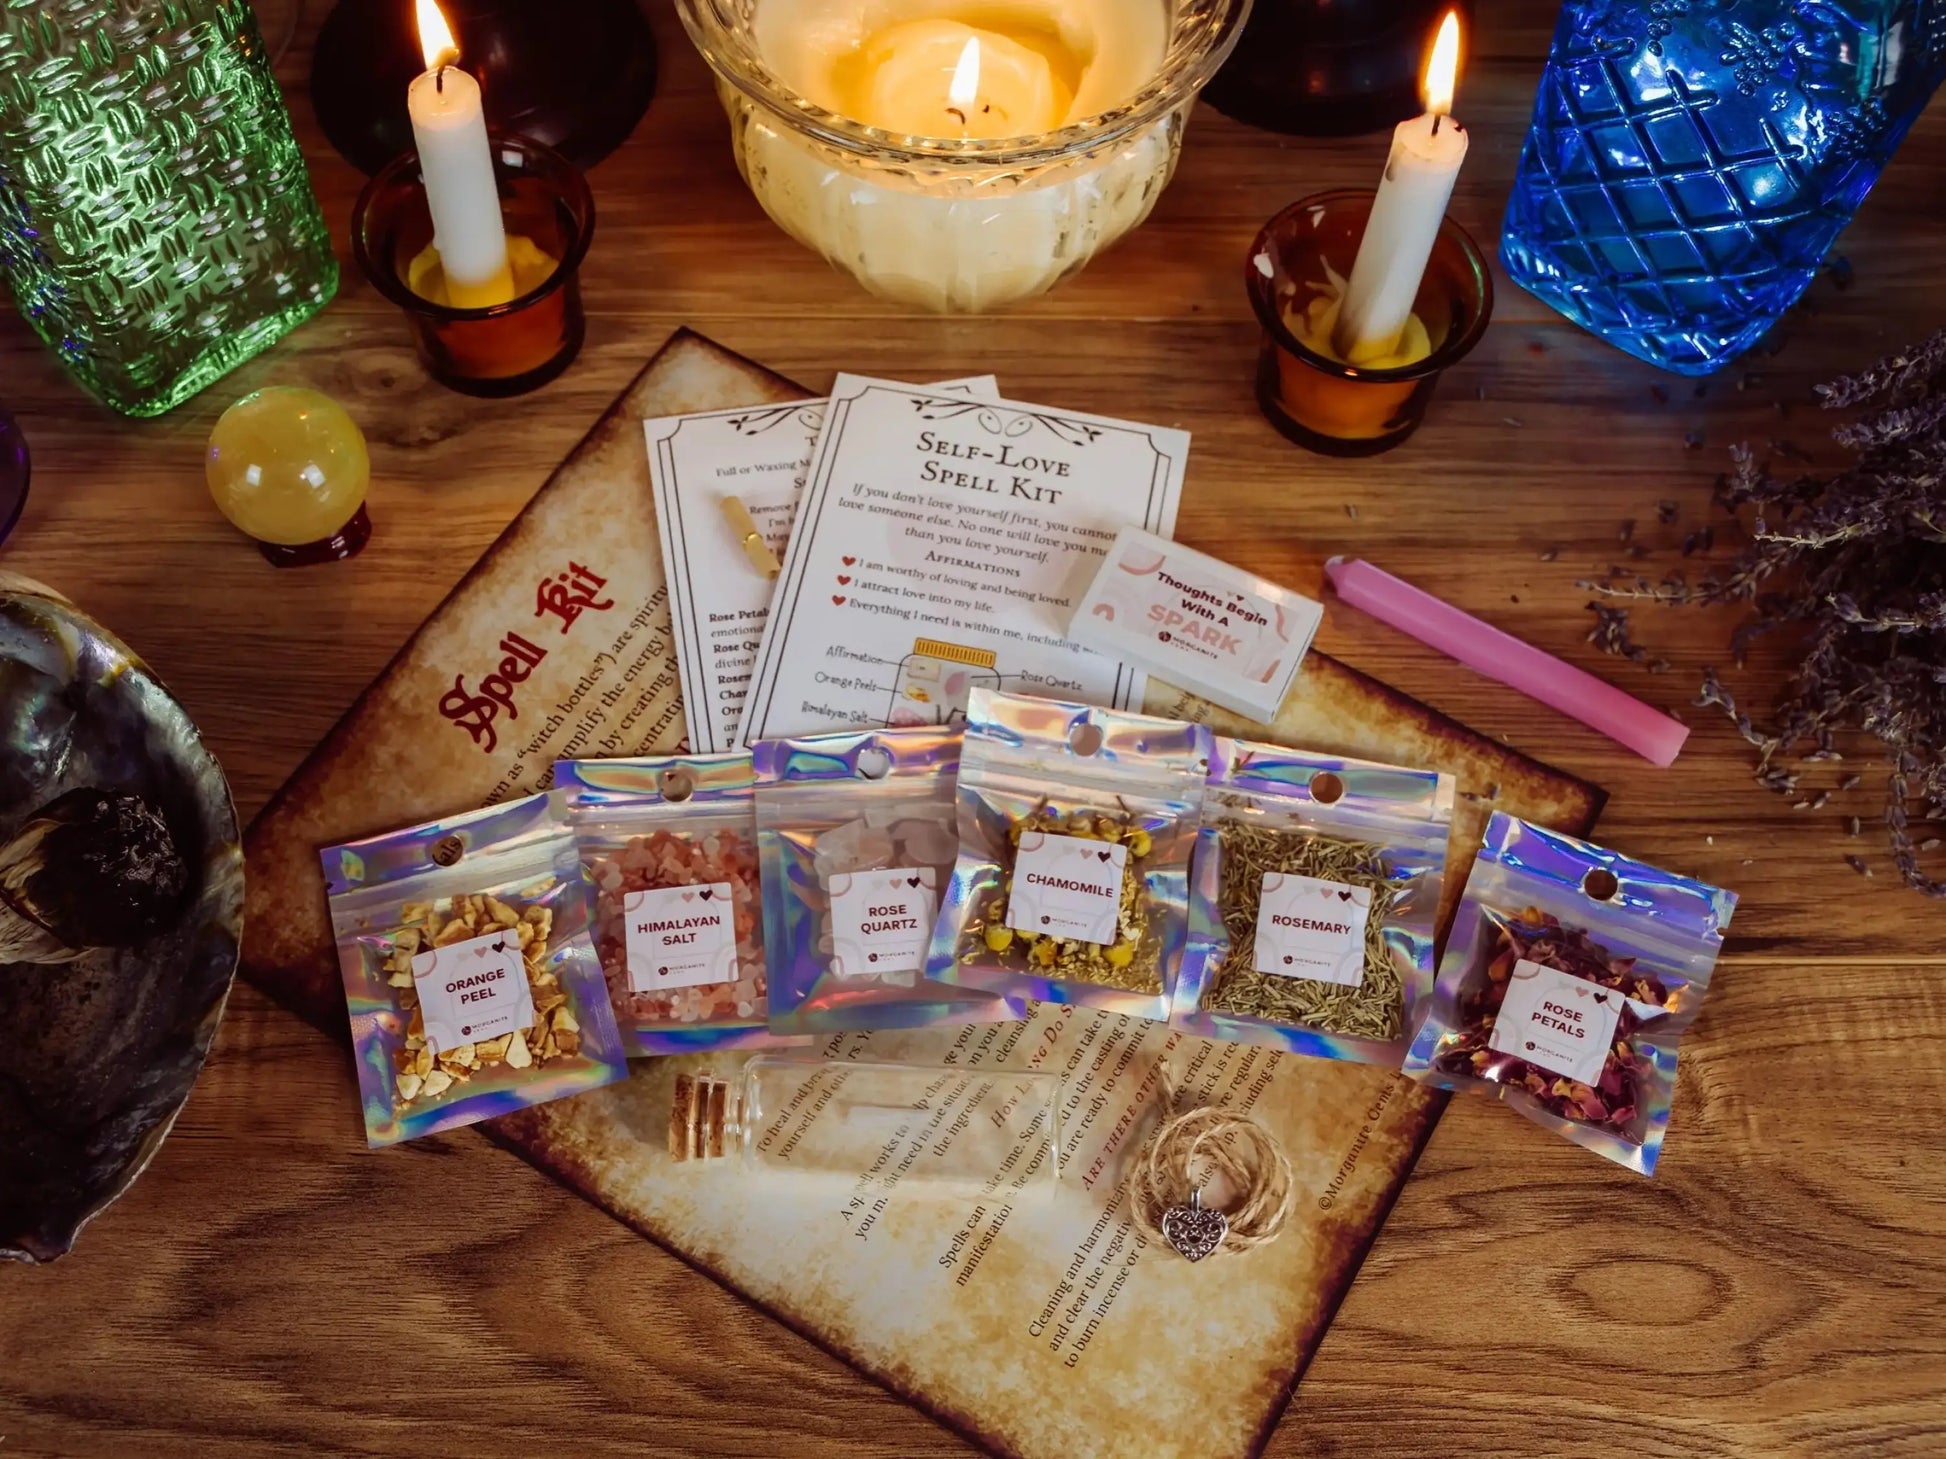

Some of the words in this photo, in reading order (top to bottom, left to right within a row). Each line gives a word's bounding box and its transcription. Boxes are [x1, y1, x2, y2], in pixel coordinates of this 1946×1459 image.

[716, 467, 737, 476] Full
[739, 467, 751, 475] or
[754, 460, 797, 472] Waxing
[838, 497, 865, 510] love
[867, 503, 923, 521] someone
[927, 512, 954, 527] else.
[958, 518, 976, 532] No
[979, 525, 1002, 536] one
[1006, 528, 1031, 542] will
[1035, 533, 1060, 547] love
[1063, 540, 1087, 552] you
[852, 483, 863, 496] If
[866, 487, 889, 501] you
[892, 490, 924, 505] don't
[928, 496, 953, 510] love
[956, 502, 1009, 522] yourself
[1010, 510, 1041, 528] first,
[1045, 519, 1068, 533] you
[905, 526, 934, 541] than
[939, 533, 962, 546] you
[965, 537, 991, 551] love
[994, 543, 1050, 563] yourself.
[854, 578, 860, 588] I
[861, 579, 899, 595] attract
[902, 587, 926, 600] love
[929, 592, 951, 605] into
[954, 599, 972, 611] my
[974, 600, 995, 613] life.
[859, 558, 866, 568] I
[865, 561, 884, 572] am
[886, 563, 927, 582] worthy
[929, 572, 942, 583] of
[944, 575, 978, 591] loving
[981, 581, 1002, 594] and
[1005, 585, 1042, 603] being
[1039, 592, 1072, 608] loved.
[1158, 571, 1223, 607] Thoughts
[1226, 602, 1268, 626] Begin
[709, 613, 735, 623] Rose
[738, 608, 770, 620] Petal
[849, 598, 910, 620] Everything
[913, 609, 918, 619] I
[920, 611, 949, 626] need
[951, 617, 961, 628] is
[964, 621, 1000, 636] within
[1003, 628, 1024, 641] me,
[1026, 631, 1081, 652] including
[1147, 604, 1242, 656] SPARK
[1181, 599, 1215, 621] With
[1218, 617, 1229, 627] A
[439, 631, 548, 754] Spell
[534, 560, 614, 635] Kit
[713, 644, 739, 654] Rose
[743, 641, 760, 651] Qu
[714, 657, 750, 669] divine
[508, 763, 524, 780] as
[612, 630, 633, 653] are
[630, 584, 668, 631] spiritu
[601, 682, 626, 708] the
[623, 635, 665, 683] energy
[718, 674, 752, 685] Rosem
[815, 671, 852, 688] Orange
[854, 676, 877, 691] Peels
[1020, 670, 1043, 683] Rose
[1045, 674, 1083, 691] Quartz
[599, 729, 625, 751] by
[620, 673, 673, 730] creating
[1026, 873, 1114, 898] CHAMOMILE
[637, 915, 720, 933] HIMALAYAN
[860, 919, 918, 935] QUARTZ
[868, 904, 907, 917] ROSE
[1272, 914, 1351, 935] ROSEMARY
[662, 933, 697, 946] SALT
[446, 968, 505, 993] ORANGE
[461, 988, 496, 1005] PEEL
[1531, 1012, 1585, 1038] PETALS
[1543, 1001, 1584, 1022] ROSE
[1012, 1174, 1029, 1190] Be
[1066, 1095, 1080, 1110] to
[1076, 1072, 1094, 1095] the
[1091, 1027, 1125, 1072] casting
[1067, 1129, 1084, 1152] are
[1080, 1092, 1109, 1129] ready
[1101, 1078, 1116, 1093] to
[1112, 1029, 1146, 1077] commit
[1367, 1084, 1394, 1121] Gems
[767, 1109, 792, 1138] heal
[789, 1088, 808, 1111] and
[778, 1109, 816, 1160] yourself
[813, 1089, 833, 1112] and
[855, 1213, 876, 1242] you
[898, 1141, 923, 1173] need
[978, 1028, 998, 1054] you
[932, 1136, 952, 1157] the
[938, 1229, 970, 1269] Spells
[967, 1205, 987, 1229] can
[1000, 1145, 1026, 1174] time.
[1019, 1109, 1048, 1143] Some
[1066, 1047, 1085, 1071] can
[1080, 1019, 1102, 1046] take
[840, 1208, 853, 1222] A
[870, 1138, 900, 1174] works
[1028, 1280, 1074, 1338] Cleaning
[1066, 1252, 1087, 1281] and
[1183, 1039, 1214, 1084] critical
[1049, 1324, 1070, 1352] and
[1066, 1291, 1090, 1324] clear
[1085, 1266, 1104, 1290] the
[1100, 1220, 1132, 1266] negativ
[1197, 1071, 1221, 1103] stick
[1213, 1060, 1228, 1072] is
[1064, 1352, 1079, 1368] to
[1072, 1319, 1100, 1352] burn
[1093, 1265, 1130, 1318] incense
[1126, 1249, 1141, 1266] or
